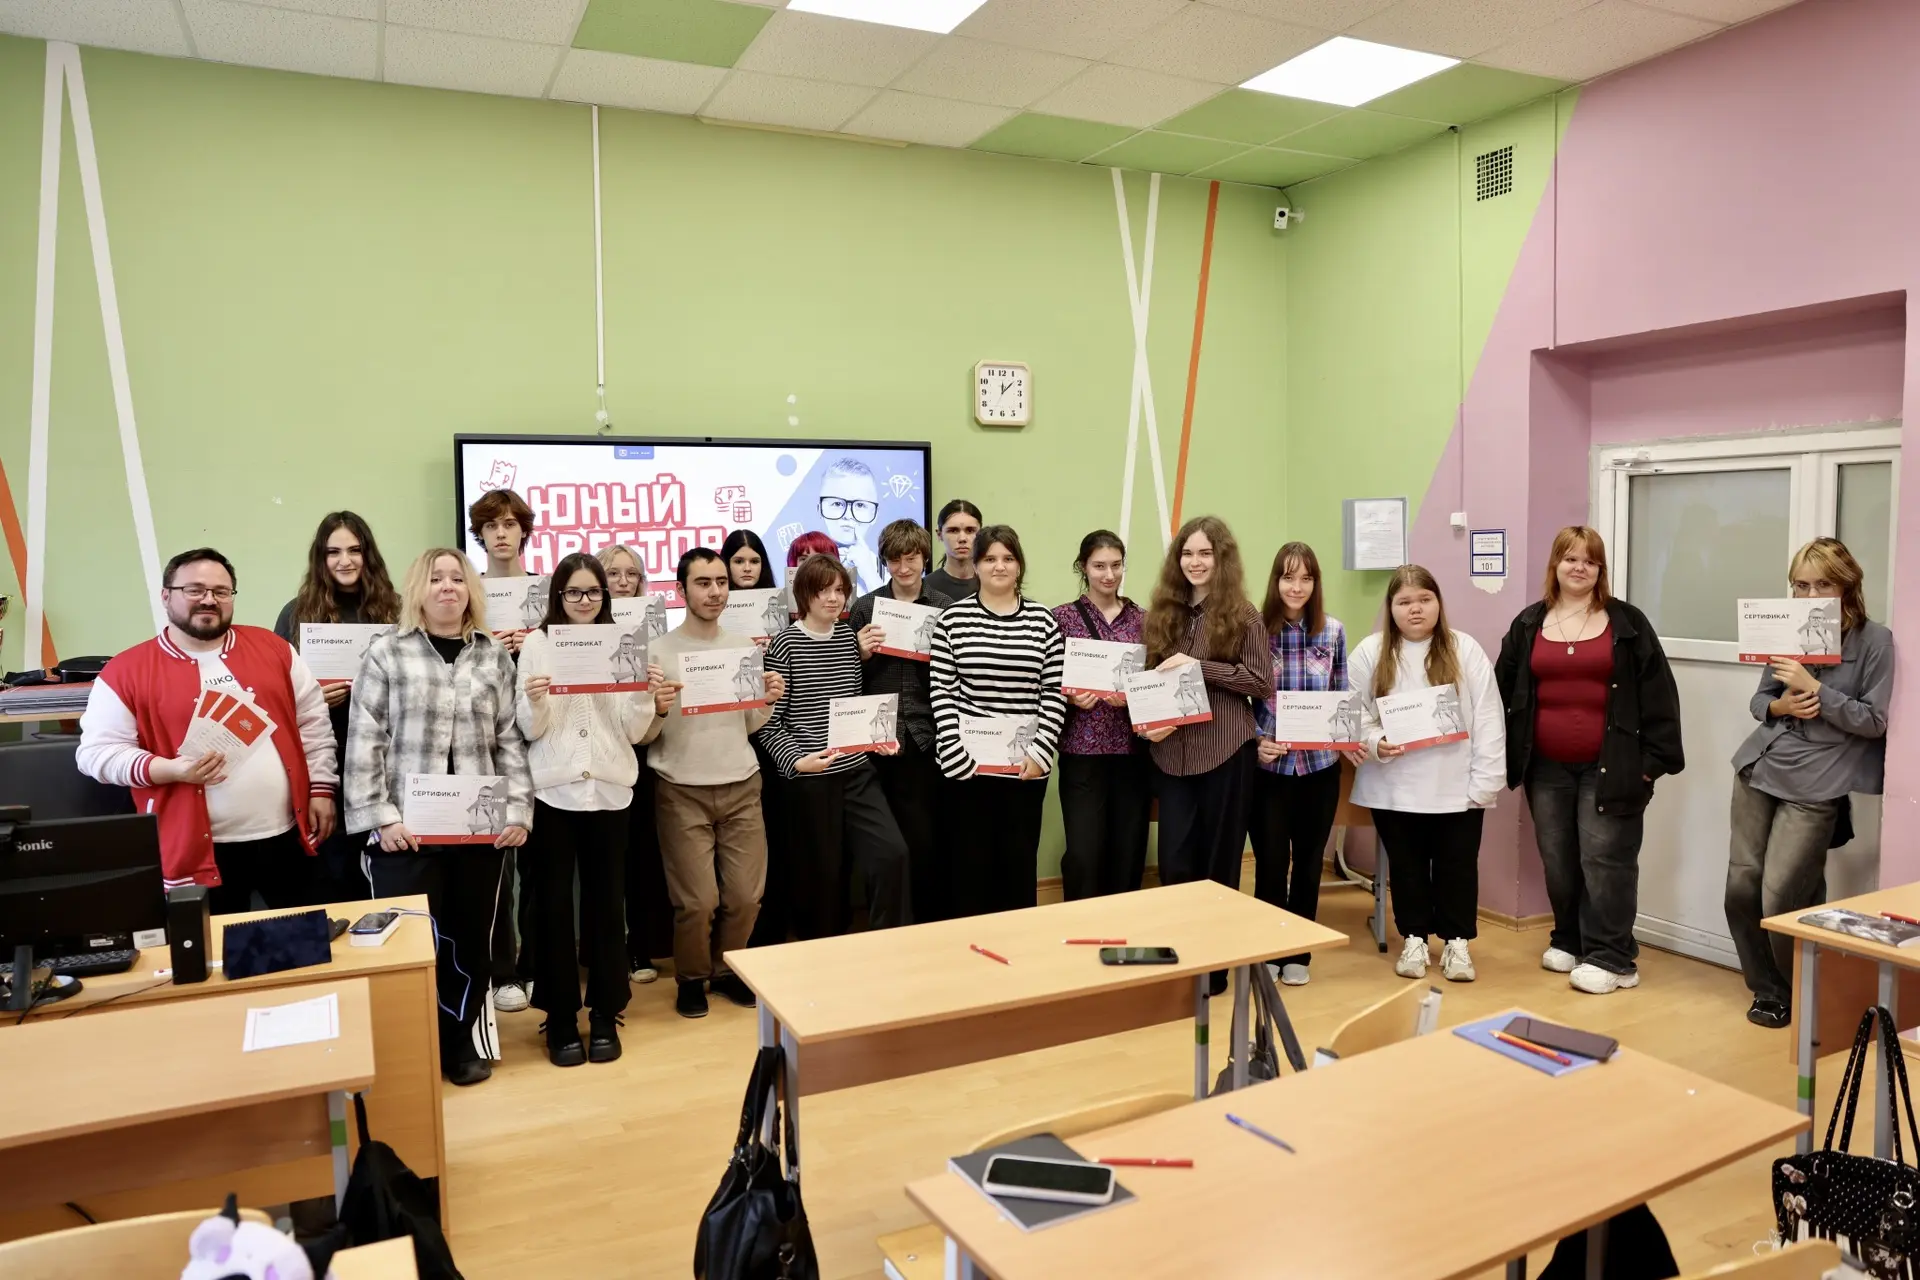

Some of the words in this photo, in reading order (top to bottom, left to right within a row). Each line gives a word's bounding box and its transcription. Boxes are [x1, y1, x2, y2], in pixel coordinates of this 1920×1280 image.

[998, 369, 1007, 377] 12
[989, 409, 994, 417] 7
[527, 473, 686, 531] ЮНЫЙ
[1481, 562, 1493, 571] 101
[555, 640, 603, 648] СЕРТИФИКАТ
[1070, 651, 1108, 660] СЕРТИФИКАТ
[685, 664, 725, 673] СЕРТИФИКАТ
[1129, 682, 1166, 693] СЕРТИФИКАТ
[1385, 702, 1423, 715] СЕРТИФИКАТ
[412, 790, 460, 798] СЕРТИФИКАТ
